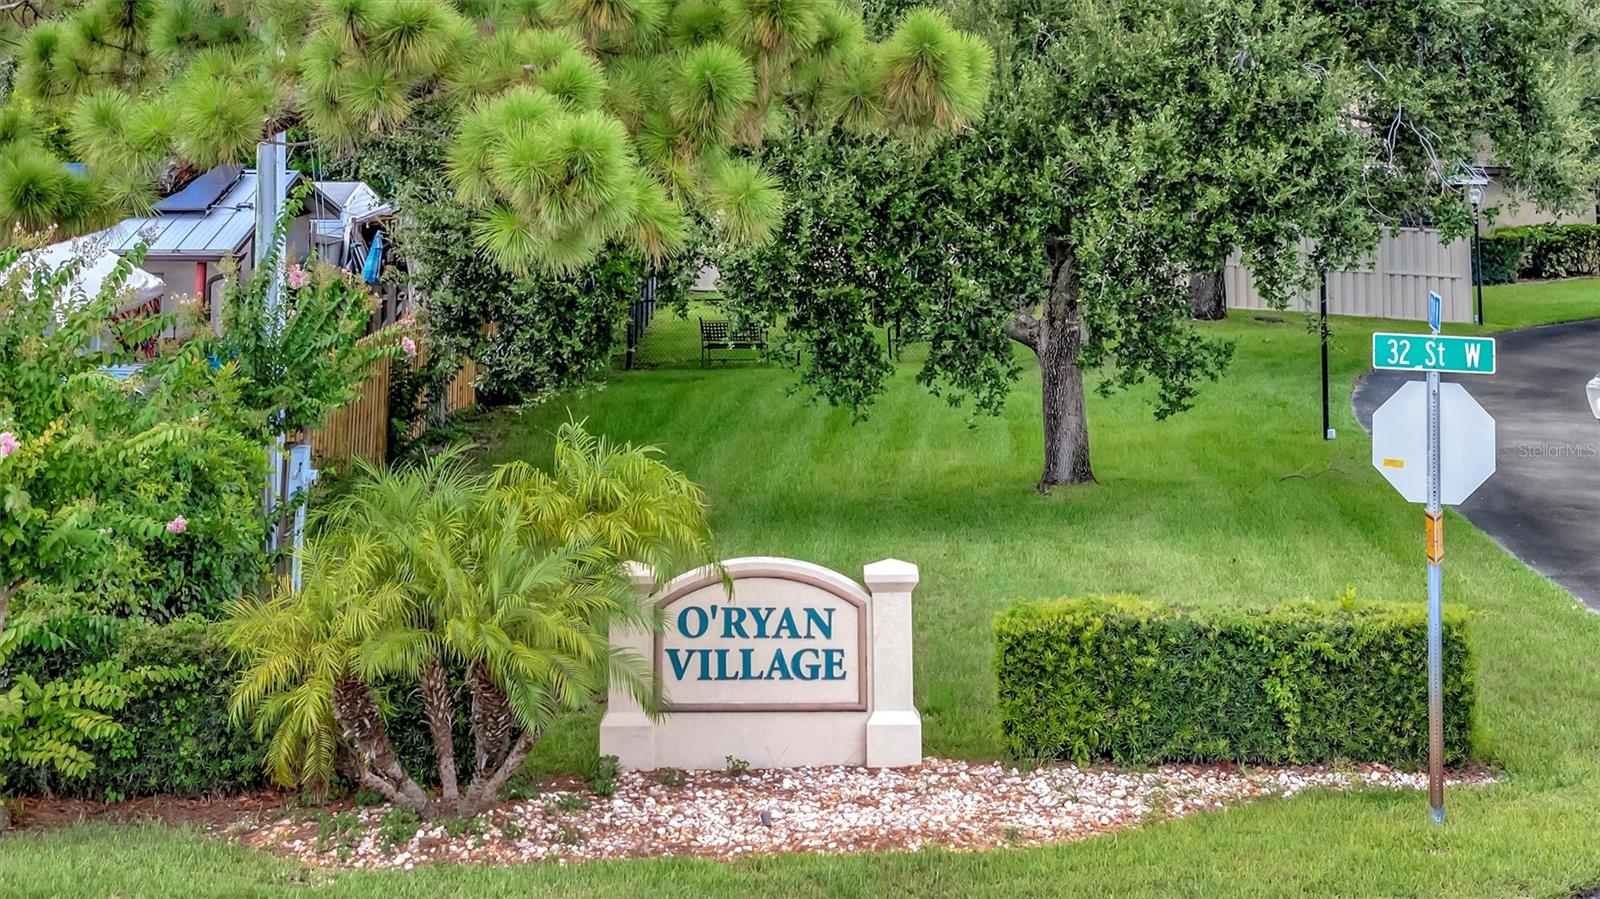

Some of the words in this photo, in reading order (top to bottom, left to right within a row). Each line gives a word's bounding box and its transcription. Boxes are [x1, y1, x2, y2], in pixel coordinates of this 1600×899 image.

[1387, 339, 1410, 364] 32
[1424, 341, 1446, 366] St
[1464, 343, 1481, 368] W
[677, 604, 836, 640] O'RYAN
[664, 648, 848, 681] VILLAGE
